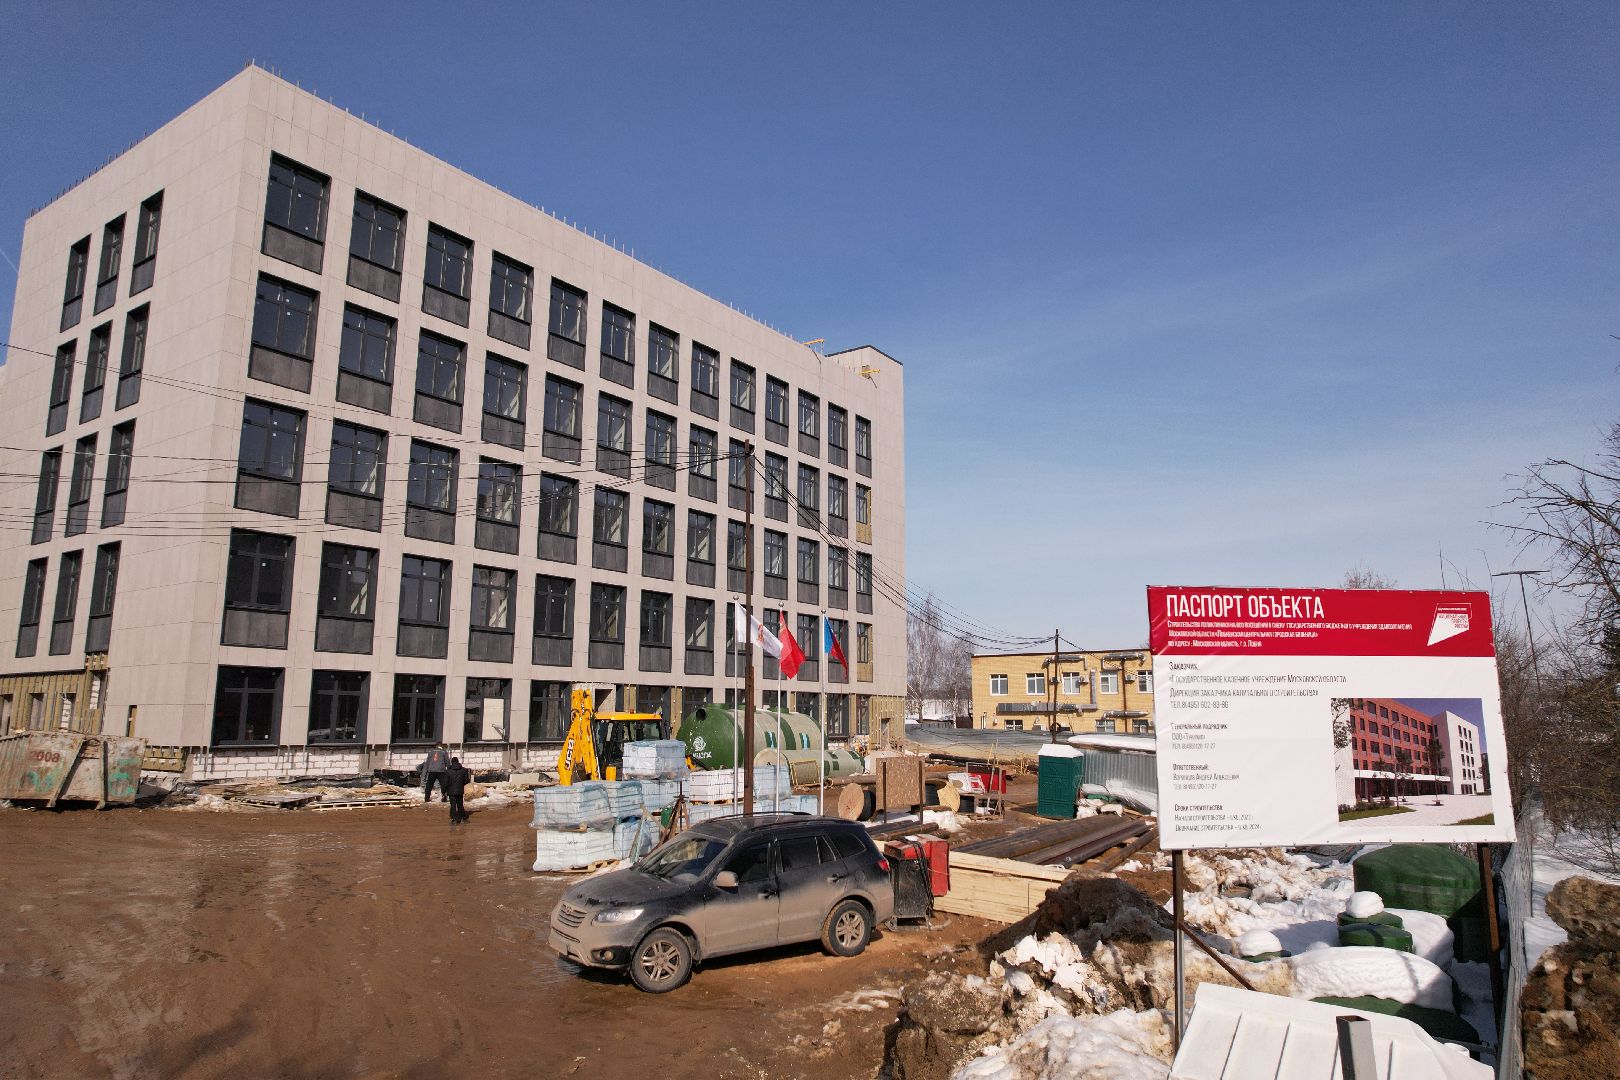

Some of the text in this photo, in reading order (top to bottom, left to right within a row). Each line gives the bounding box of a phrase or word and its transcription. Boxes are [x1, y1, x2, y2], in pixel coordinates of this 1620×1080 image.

[1166, 594, 1325, 619] ПАСПОРТ ОБЪЕКТА
[564, 737, 575, 771] JCB
